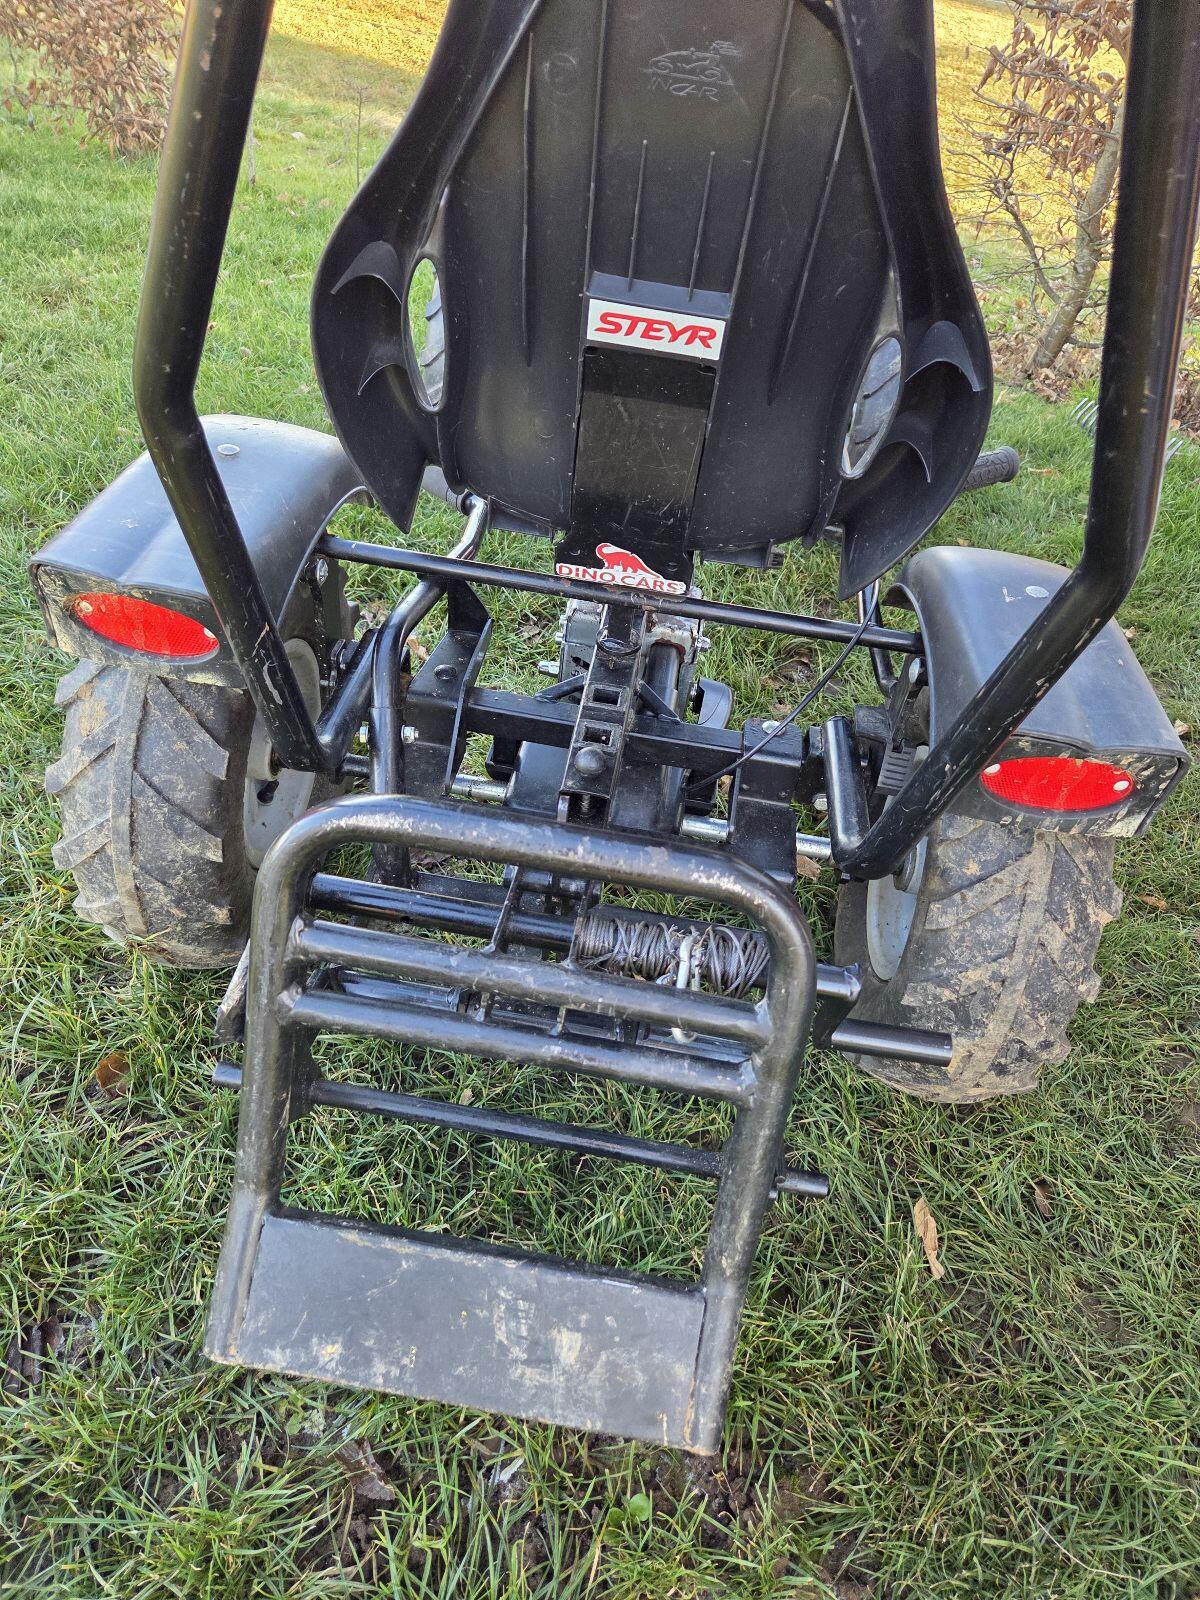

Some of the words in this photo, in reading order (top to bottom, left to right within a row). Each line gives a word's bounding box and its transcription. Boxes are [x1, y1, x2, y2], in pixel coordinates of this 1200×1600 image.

[594, 312, 717, 349] STEYR
[558, 565, 616, 582] DINO
[621, 576, 678, 592] CARS
